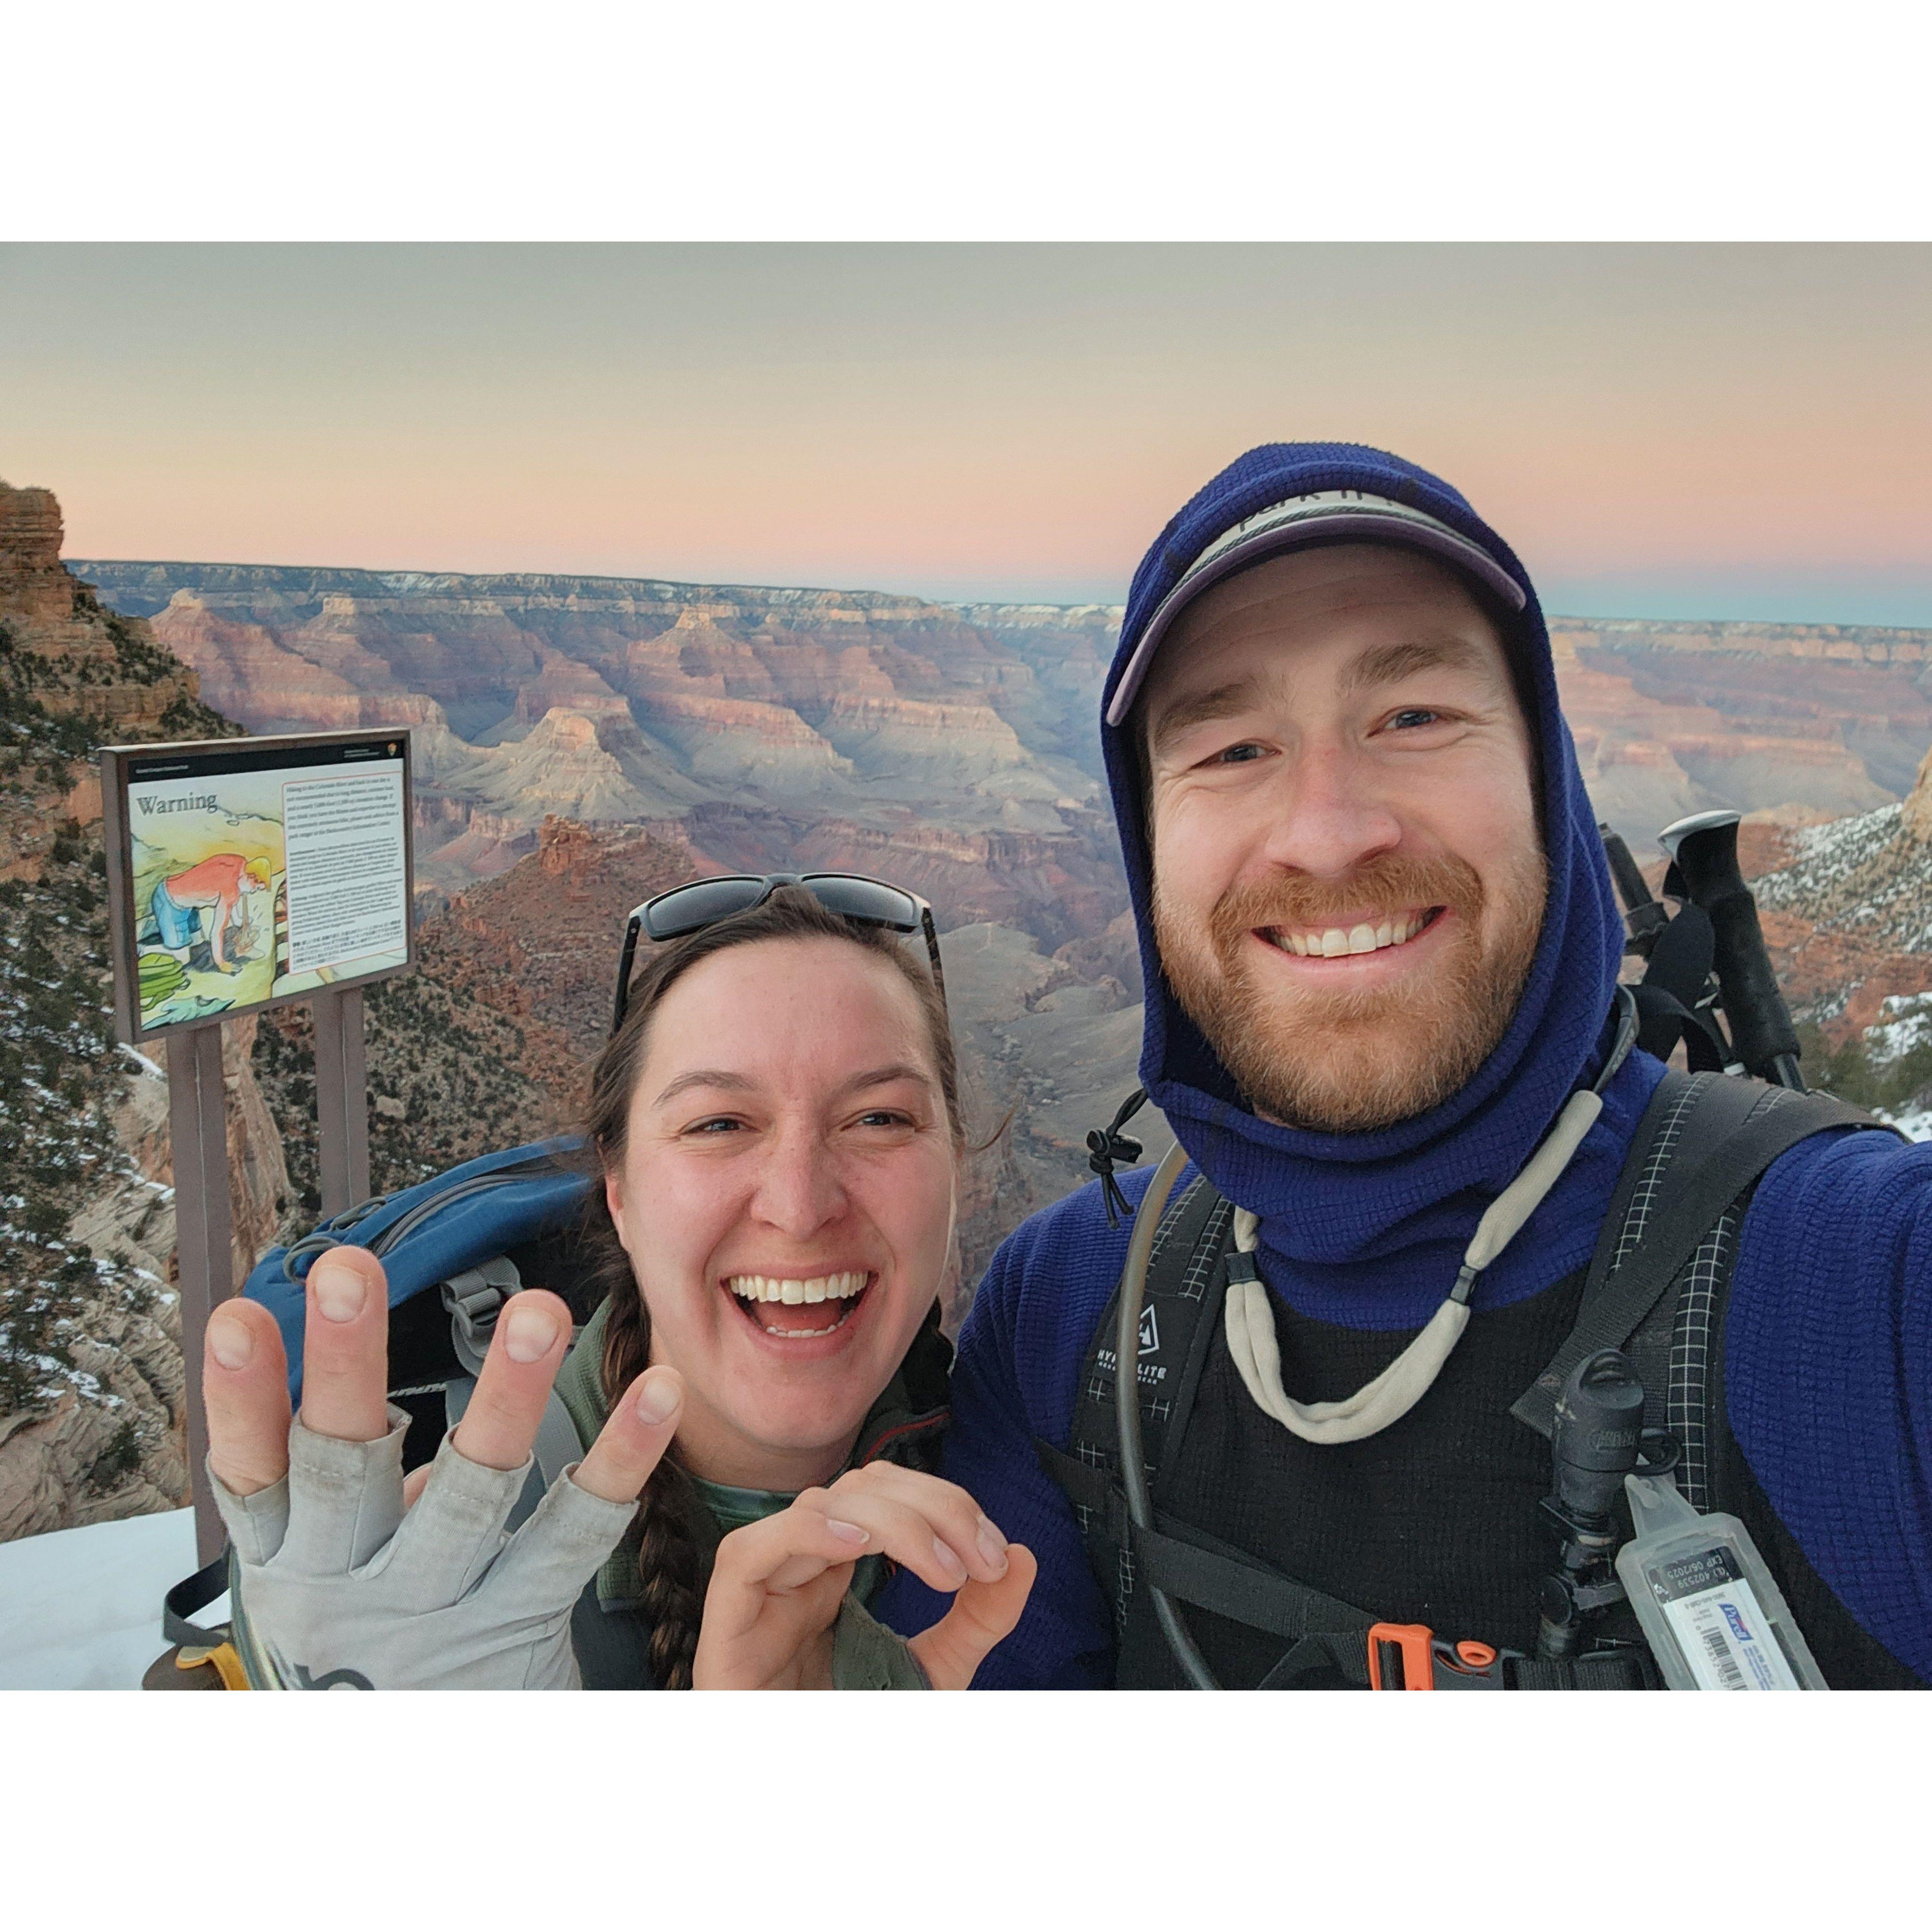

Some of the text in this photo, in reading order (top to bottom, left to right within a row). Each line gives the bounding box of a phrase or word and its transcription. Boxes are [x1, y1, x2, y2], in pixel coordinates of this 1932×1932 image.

[136, 792, 218, 816] Warning
[1668, 1554, 1723, 1579] EXP 06/2025
[1677, 1571, 1710, 1588] 402539
[1723, 1605, 1749, 1639] Purell
